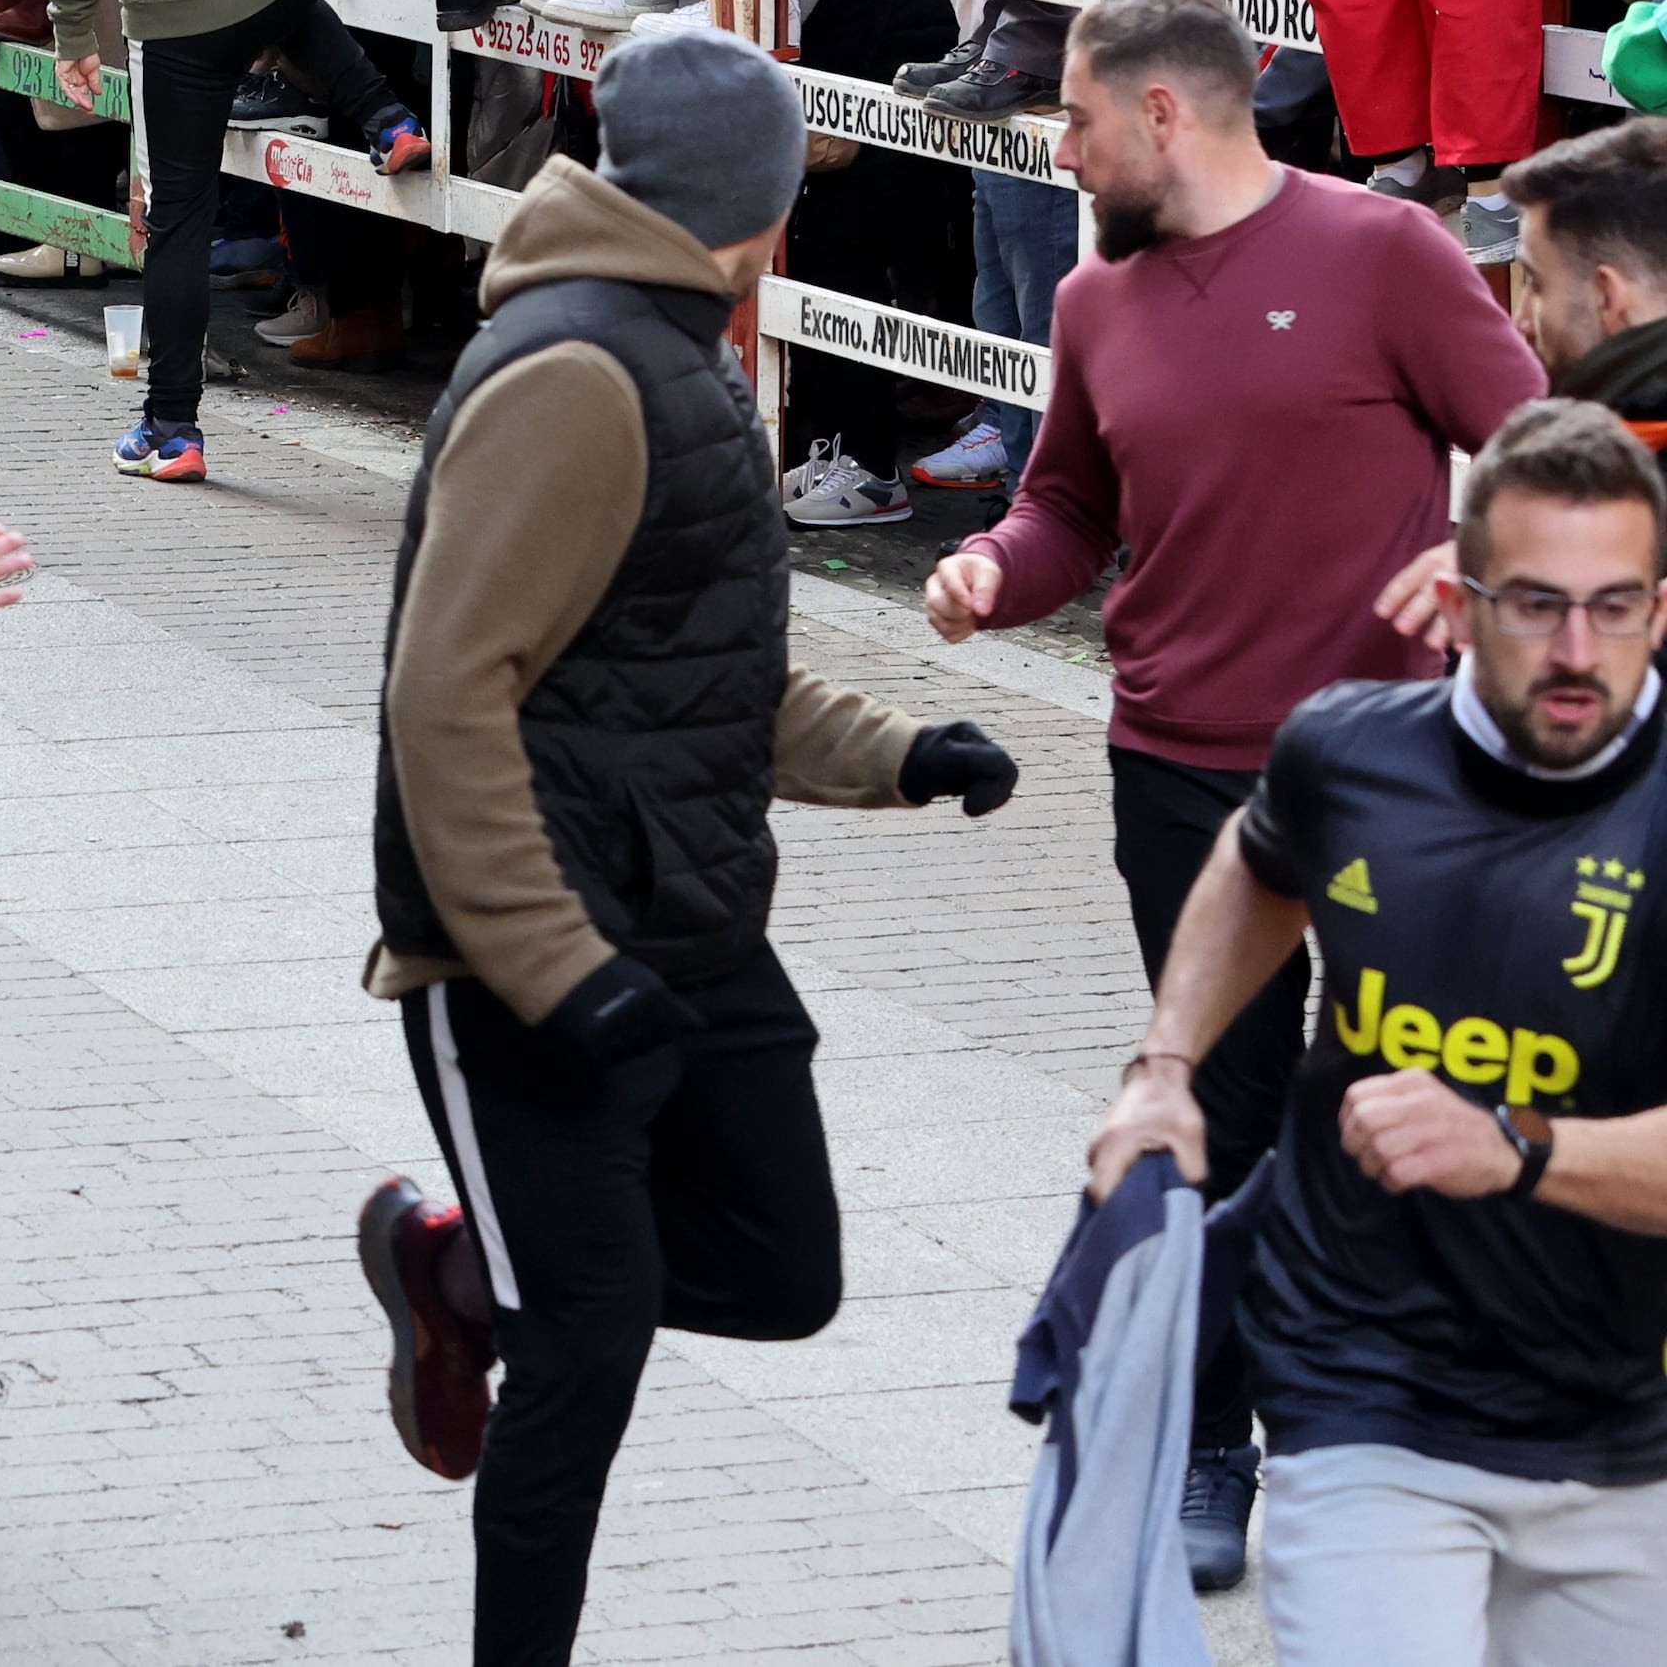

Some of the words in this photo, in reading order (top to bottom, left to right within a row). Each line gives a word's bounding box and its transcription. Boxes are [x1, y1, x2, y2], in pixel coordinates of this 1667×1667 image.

[12, 50, 43, 96] 923
[103, 74, 123, 119] 78
[488, 16, 513, 52] 923
[516, 24, 534, 56] 25
[535, 29, 550, 61] 41
[553, 33, 571, 66] 65
[802, 83, 840, 130] USO
[842, 92, 945, 155] EXCLUSIVO
[947, 120, 999, 167] CRUZ
[1001, 126, 1053, 180] ROJA
[801, 295, 868, 352] Excmo.
[871, 315, 1038, 396] AYUNTAMIENTO
[1334, 966, 1580, 1105] Jeep
